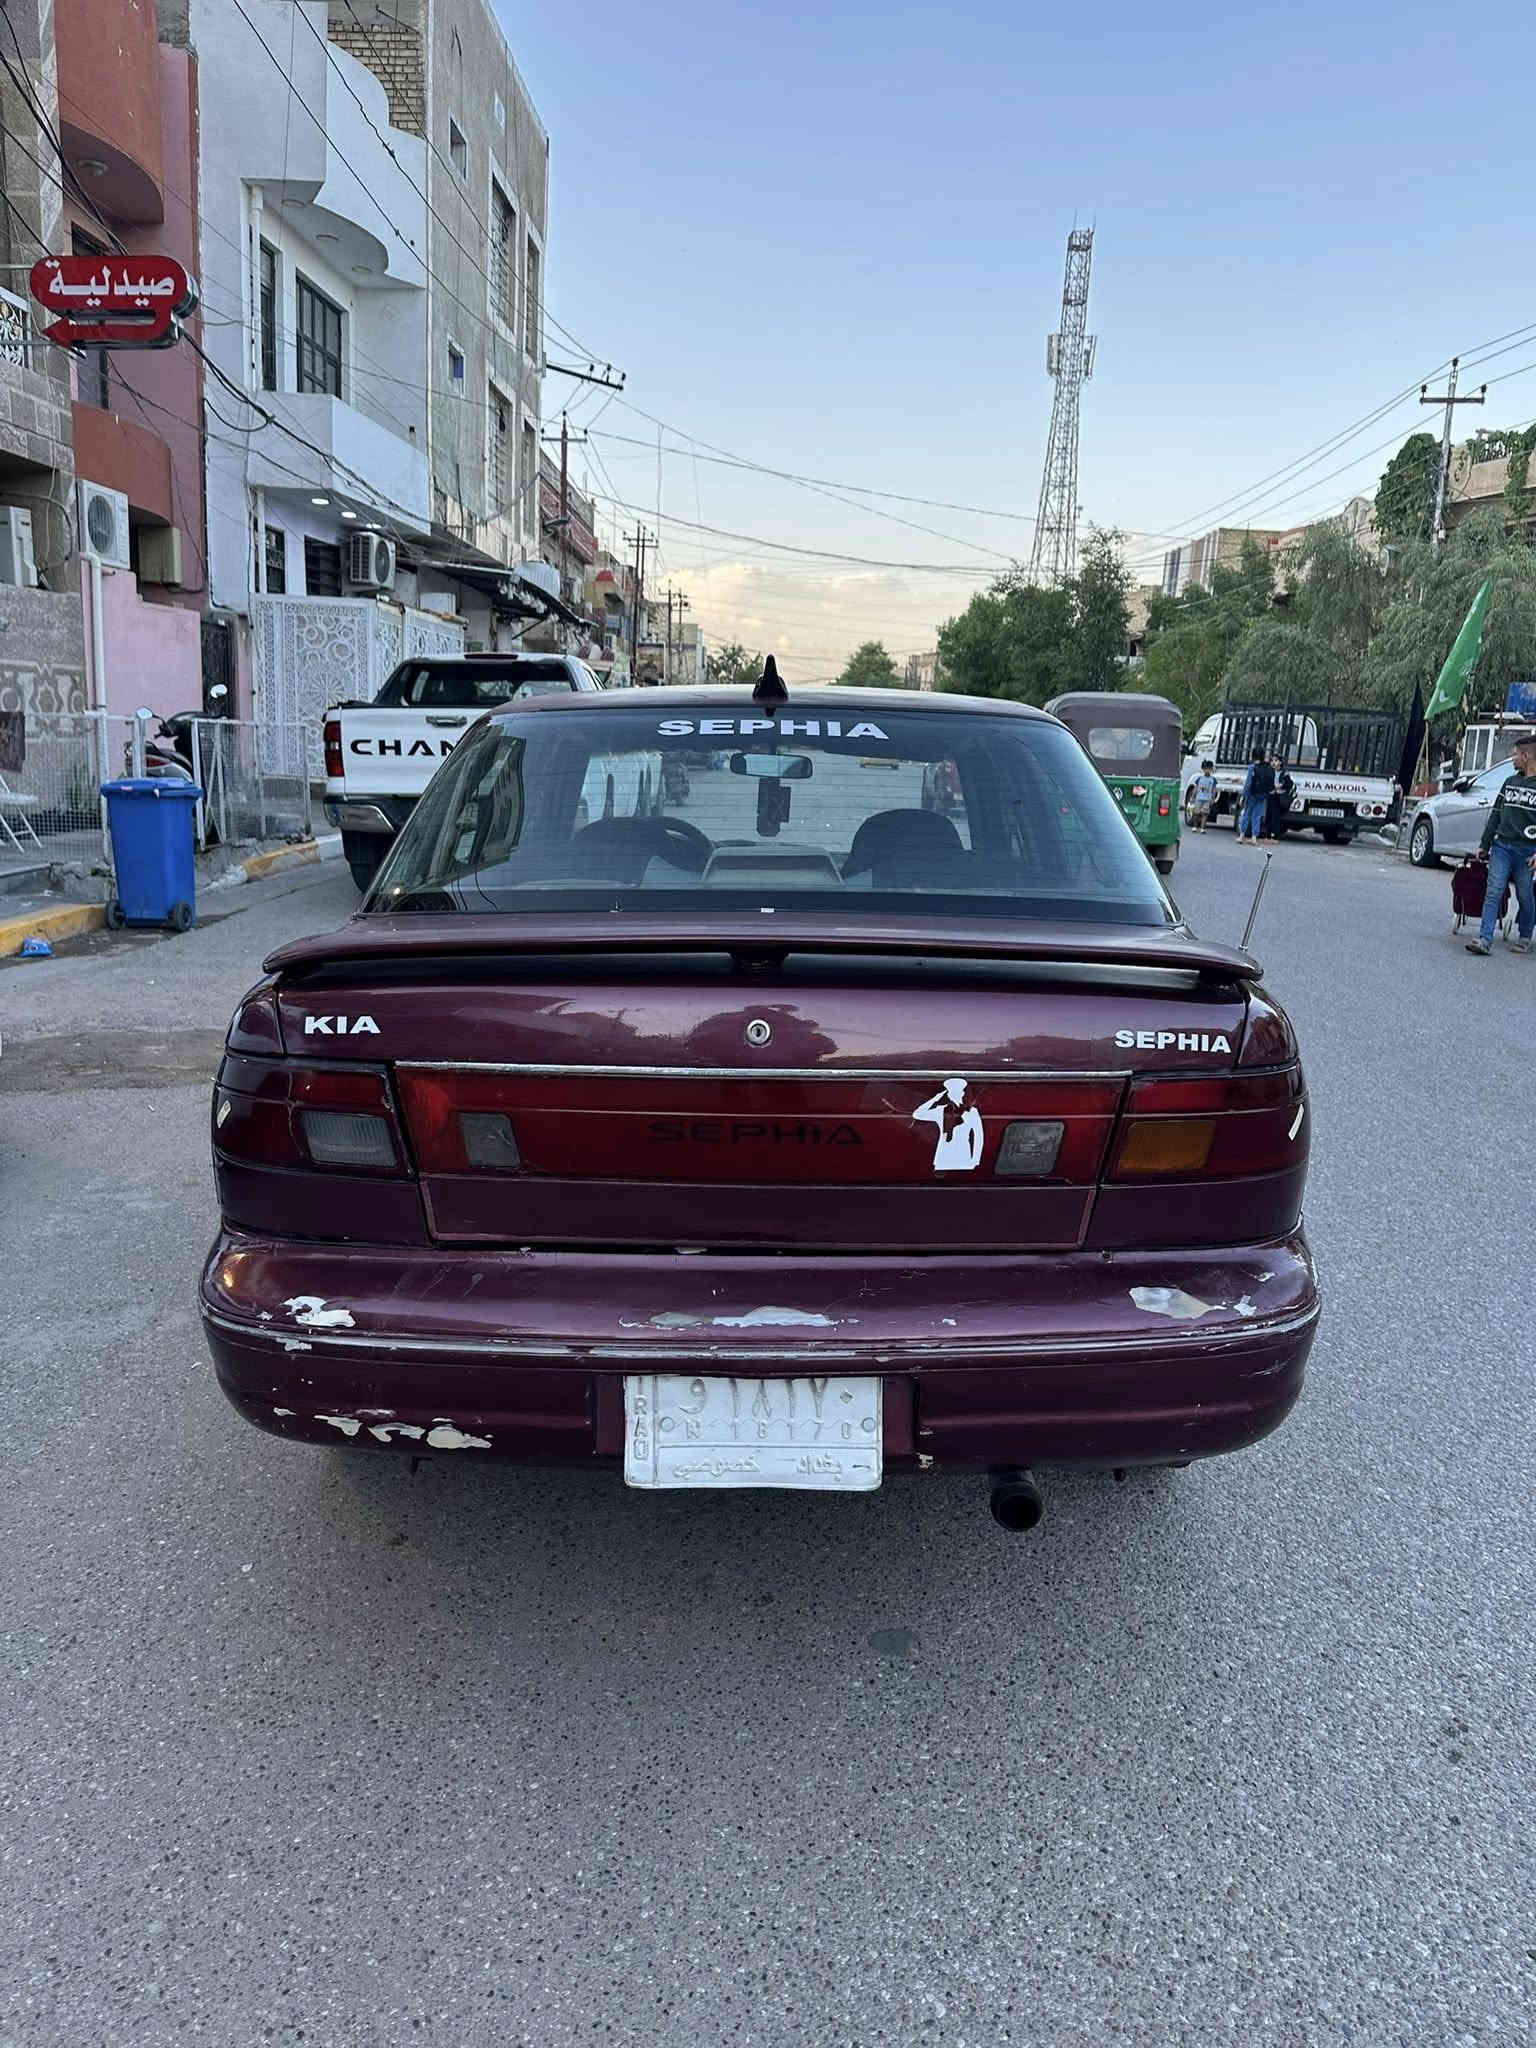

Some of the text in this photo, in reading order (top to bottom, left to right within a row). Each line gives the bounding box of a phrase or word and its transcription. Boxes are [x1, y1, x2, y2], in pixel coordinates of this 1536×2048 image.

[45, 259, 175, 306] صيدلية
[656, 718, 890, 740] SEPHIA
[1303, 780, 1368, 793] KIA MOTORS
[304, 1015, 381, 1034] KIA
[1114, 1029, 1231, 1053] SEPHIA
